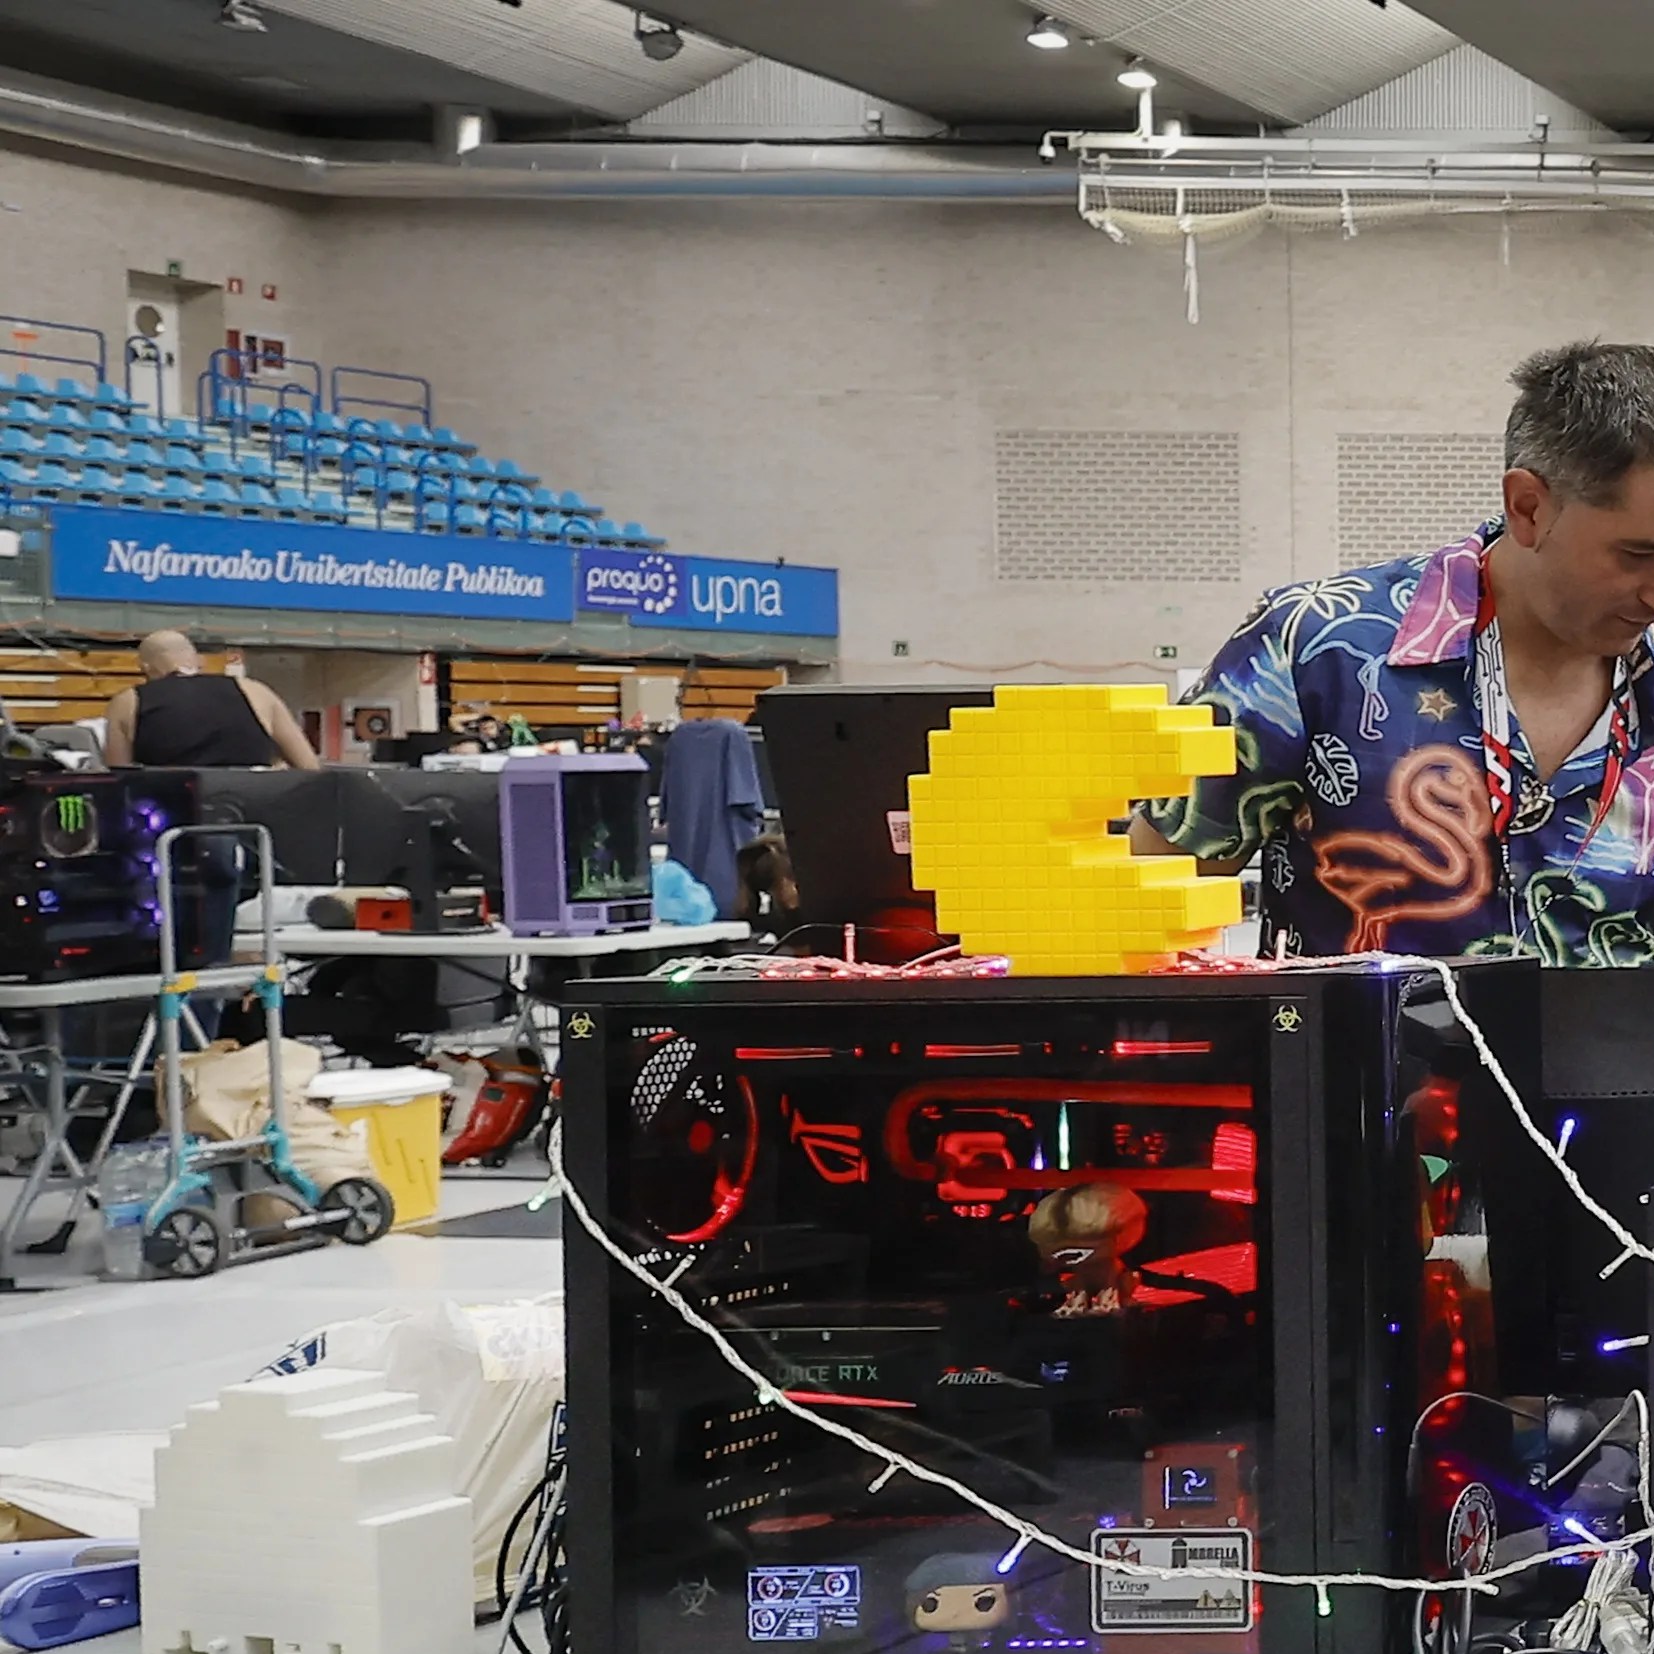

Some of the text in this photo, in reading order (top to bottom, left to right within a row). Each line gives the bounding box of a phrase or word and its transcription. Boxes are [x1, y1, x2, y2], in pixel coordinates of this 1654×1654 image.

[104, 539, 545, 598] Nafarroako Unibertsitate Publikoa
[587, 567, 664, 595] proquo
[692, 574, 783, 624] upna
[838, 1365, 878, 1381] RTX
